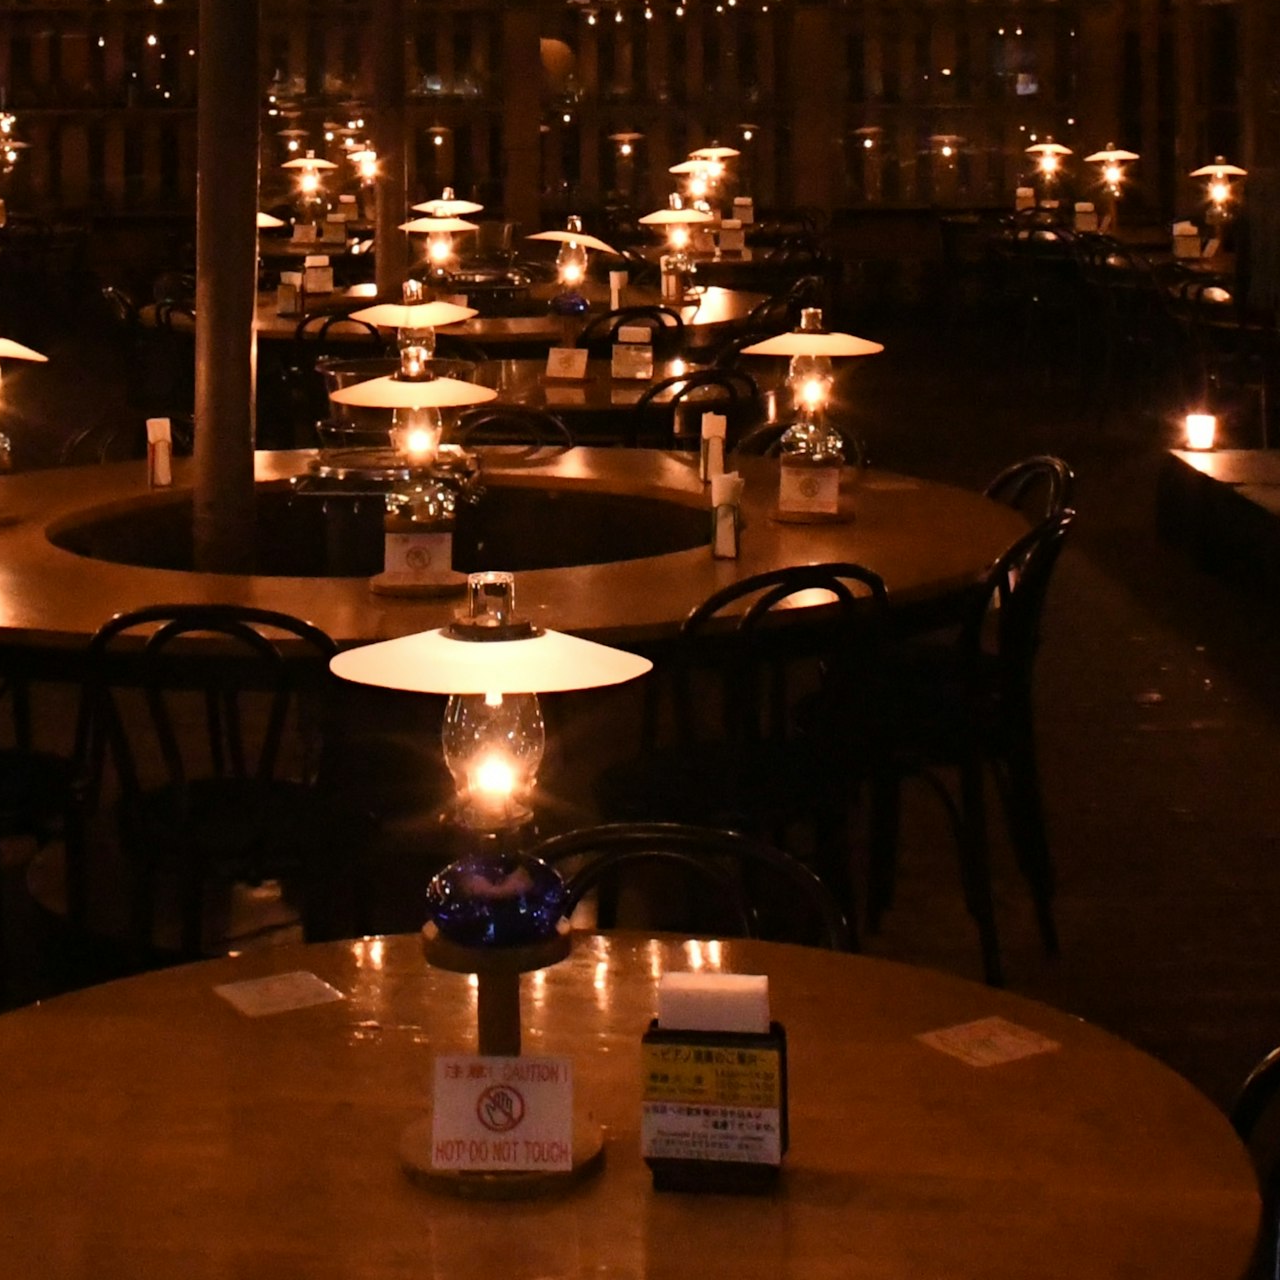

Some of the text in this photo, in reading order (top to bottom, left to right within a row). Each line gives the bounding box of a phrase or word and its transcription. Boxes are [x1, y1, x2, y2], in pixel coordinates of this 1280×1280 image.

[469, 1141, 488, 1162] DO
[493, 1142, 519, 1162] NOT
[524, 1142, 569, 1164] TOUCH
